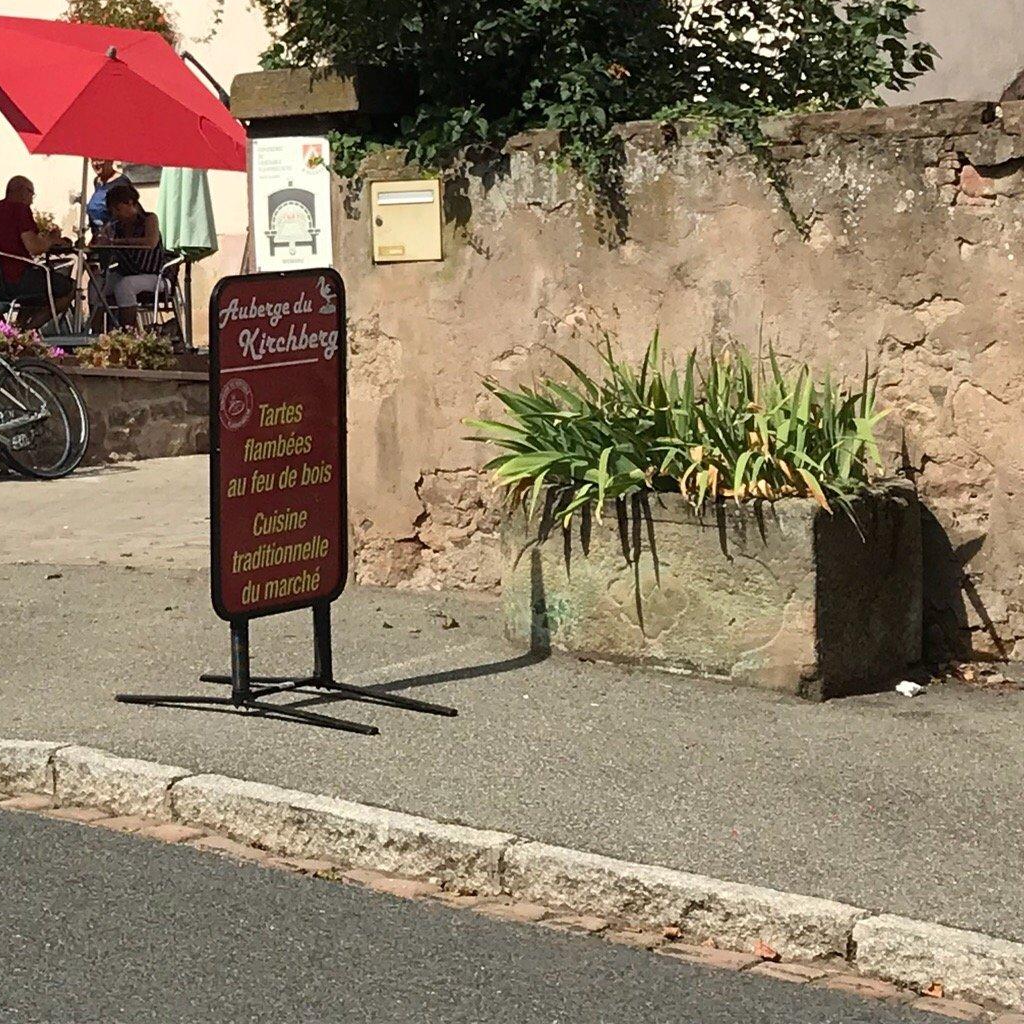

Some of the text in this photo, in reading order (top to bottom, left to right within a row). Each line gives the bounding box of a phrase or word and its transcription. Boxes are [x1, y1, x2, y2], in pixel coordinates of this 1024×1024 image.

[218, 292, 313, 329] Auberge du
[239, 323, 339, 360] Kirchberg
[259, 402, 303, 427] Tartes
[244, 432, 313, 462] flambées
[227, 460, 333, 497] au feu de bois
[253, 508, 308, 536] Cuisine
[232, 535, 329, 574] traditionnelle
[241, 566, 321, 605] du marché
